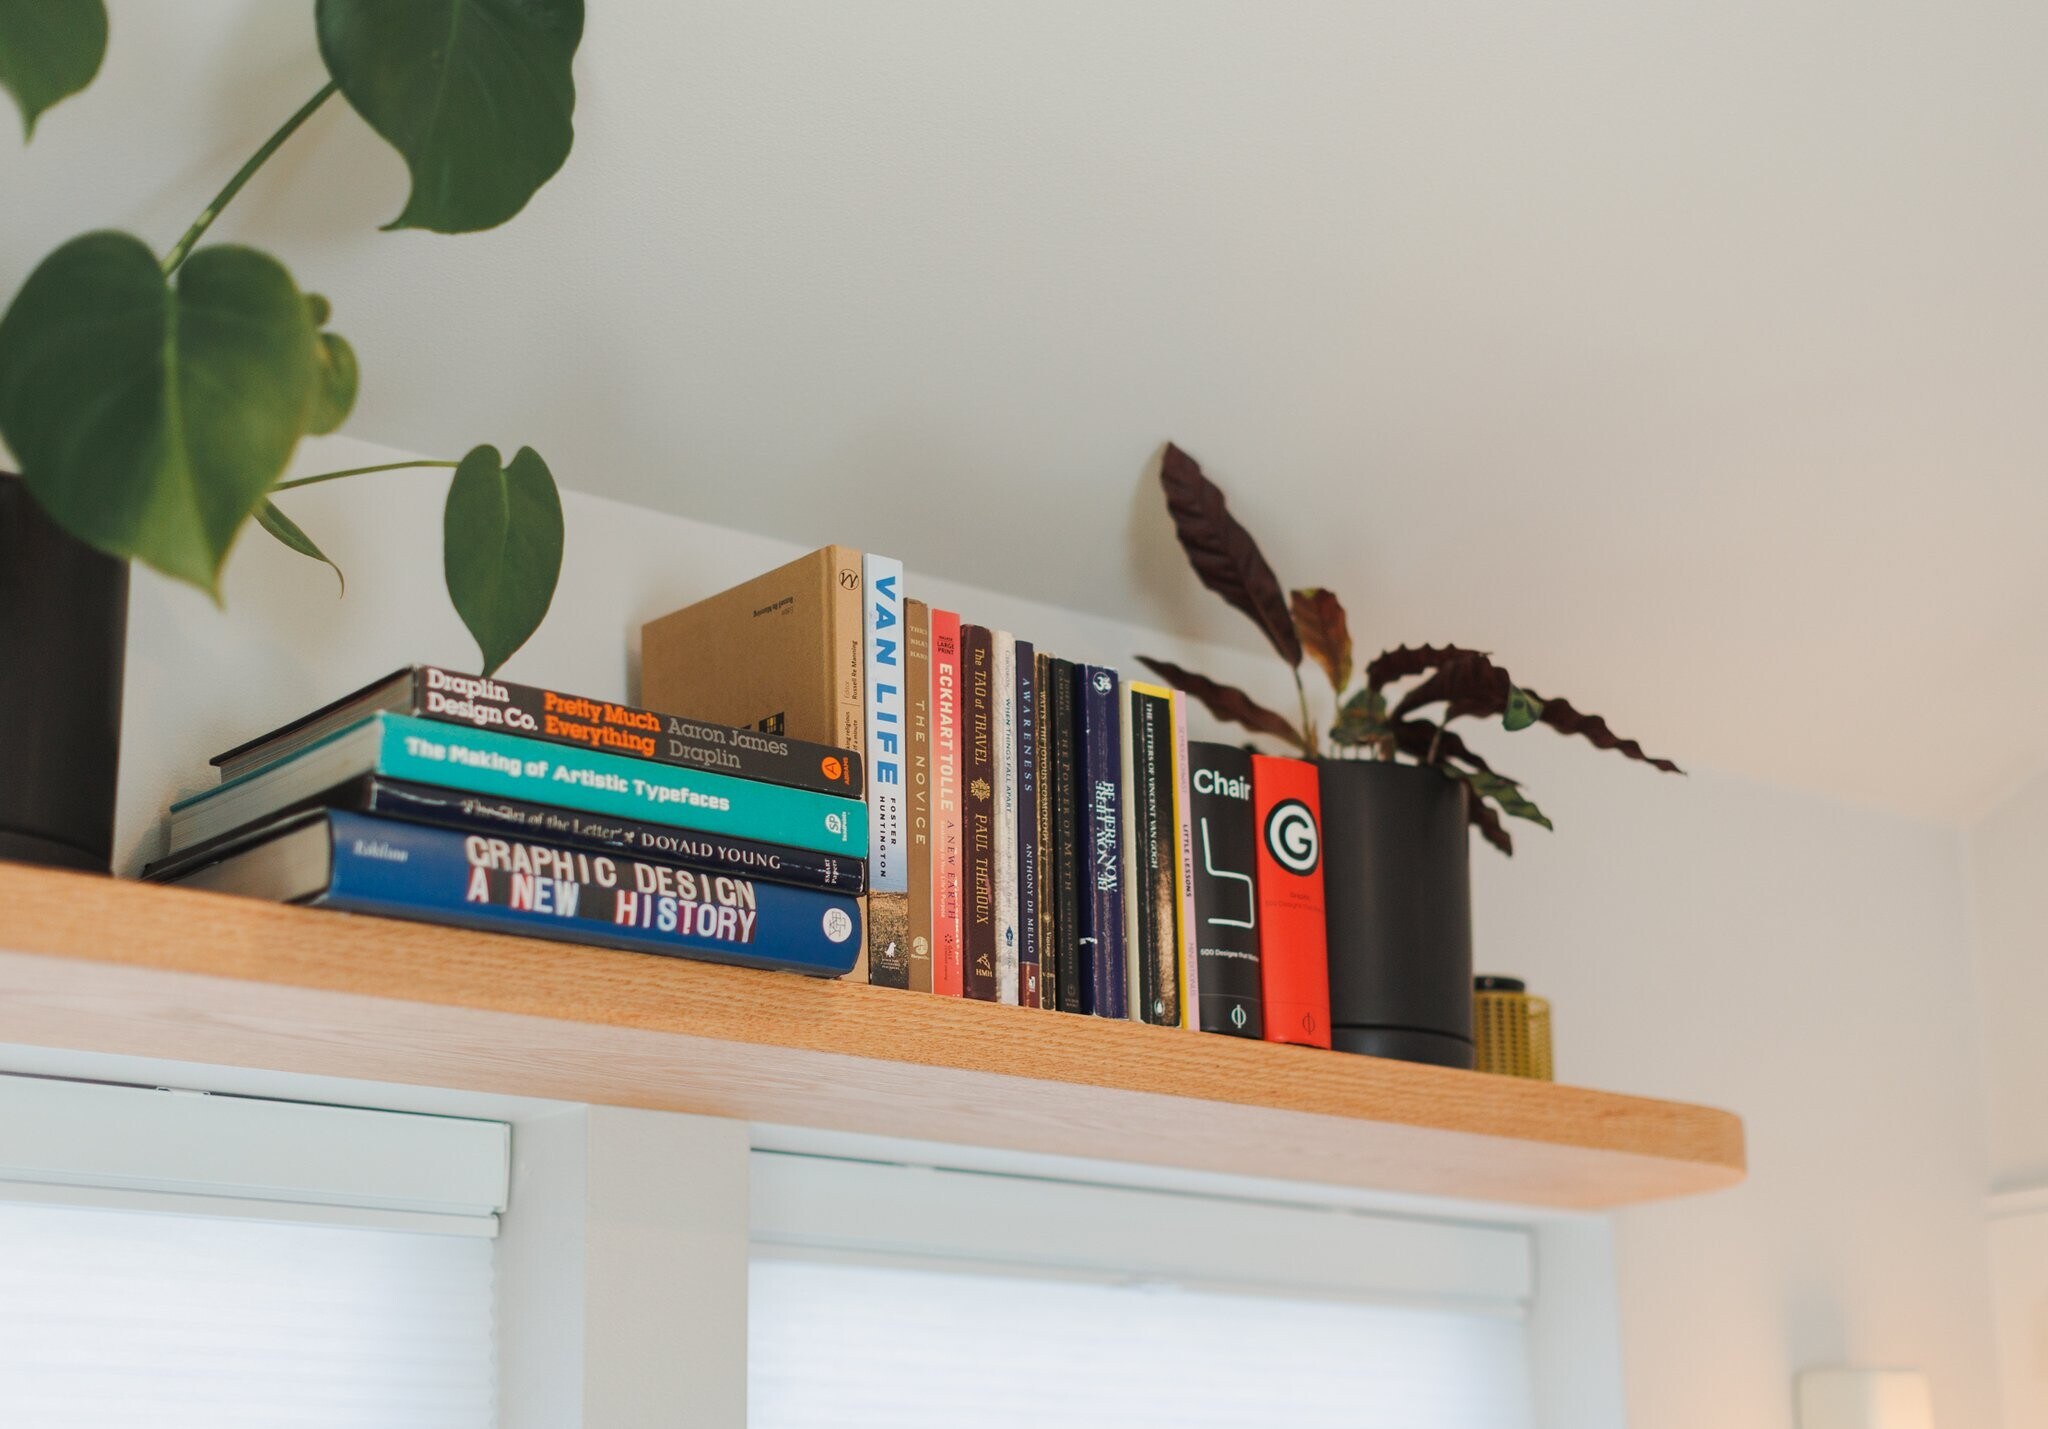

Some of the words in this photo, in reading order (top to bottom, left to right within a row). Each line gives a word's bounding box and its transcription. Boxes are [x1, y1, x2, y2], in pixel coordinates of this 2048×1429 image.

[875, 576, 896, 666] VAN
[937, 641, 954, 650] LARGE
[937, 647, 954, 656] PRINT
[974, 649, 984, 666] The
[427, 668, 510, 703] Draplin
[974, 671, 986, 697] TAO
[974, 698, 984, 709] of
[427, 691, 503, 725] Design
[504, 707, 538, 731] Co.
[544, 692, 603, 724] Pretty
[604, 703, 661, 732] Much
[915, 701, 925, 742] THE
[939, 663, 953, 749] ECKHART
[544, 714, 656, 757] Everything
[668, 717, 727, 744] Aaron
[729, 731, 789, 757] James
[669, 739, 742, 769] Draplin
[877, 683, 898, 785] LIFE
[974, 713, 987, 767] TRAVEL
[1022, 678, 1032, 791] AWARENESS
[1061, 730, 1069, 758] THE
[404, 736, 446, 761] The
[448, 745, 523, 777] Making
[525, 760, 549, 778] of
[553, 765, 629, 793] Artistic
[632, 779, 730, 812] Typefaces
[941, 752, 953, 811] TOLLE
[1039, 745, 1048, 780] JOYOUS
[1148, 763, 1154, 772] OF
[916, 757, 926, 845] NOVICE
[1062, 762, 1070, 815] POWER
[1104, 782, 1115, 802] BE
[1193, 769, 1251, 801] Chair
[527, 812, 545, 826] of
[547, 814, 571, 832] the
[574, 818, 622, 840] Letter
[947, 820, 955, 829] A
[1040, 781, 1048, 843] COSMOLOGY
[1063, 820, 1070, 836] OF
[1105, 806, 1115, 849] HERE
[642, 832, 713, 857] DOYALD
[718, 846, 781, 869] YOUNG
[947, 835, 956, 866] NEW
[975, 814, 987, 852] PAUL
[1279, 814, 1312, 861] G
[466, 834, 618, 889] GRAPHIC
[633, 861, 757, 911] DESIGN
[1025, 843, 1033, 898] ANTHONY
[1063, 842, 1072, 892] MYTH
[1106, 855, 1117, 892] NOW
[466, 865, 490, 904] A
[510, 872, 580, 918] NEW
[615, 888, 757, 944] HISTORY
[947, 872, 956, 921] EARTH
[975, 858, 989, 925] THEROUX
[1027, 902, 1034, 913] DE
[975, 969, 993, 977] HMH
[1201, 948, 1214, 956] 500
[1215, 949, 1238, 959] Designs
